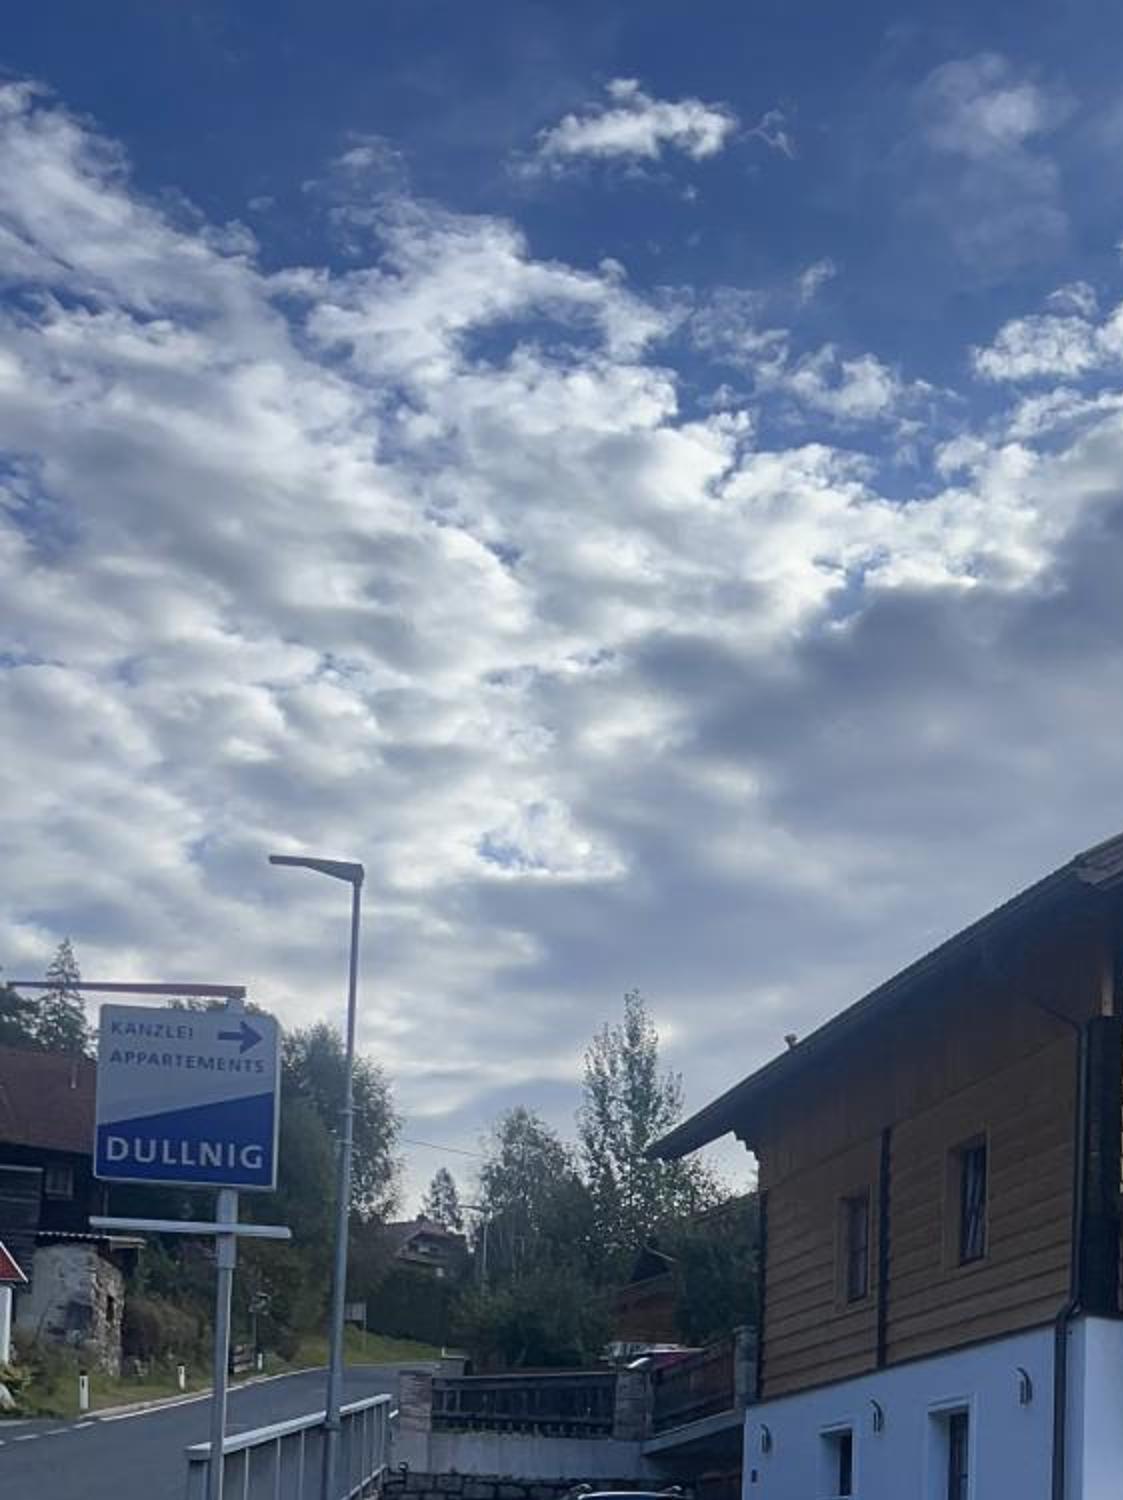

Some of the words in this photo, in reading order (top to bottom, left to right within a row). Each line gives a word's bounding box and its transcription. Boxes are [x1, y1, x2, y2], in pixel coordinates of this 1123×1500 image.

[110, 1021, 193, 1040] KANZLEI
[109, 1051, 265, 1074] APPARTEMENTS
[106, 1136, 263, 1169] DULLNIG
